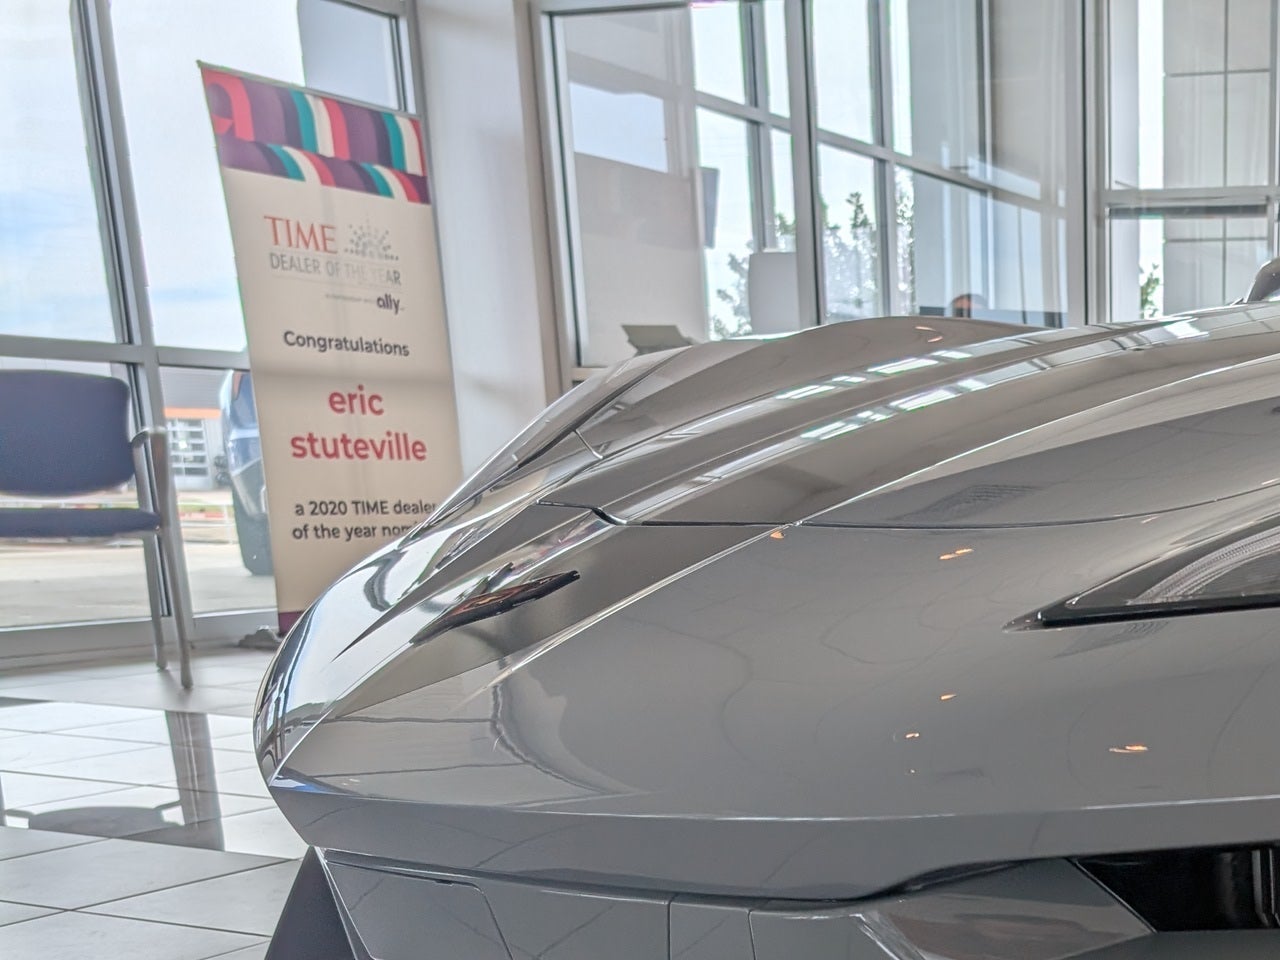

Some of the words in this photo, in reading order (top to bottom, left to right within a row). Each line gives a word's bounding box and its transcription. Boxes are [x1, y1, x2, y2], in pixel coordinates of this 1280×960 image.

[263, 215, 338, 254] TIME
[269, 252, 321, 275] DEALER
[326, 260, 341, 277] OF
[376, 293, 400, 315] ally
[283, 330, 410, 357] Congratulations
[328, 384, 385, 416] eric
[290, 430, 428, 461] stuteville
[295, 503, 304, 516] a
[309, 500, 348, 516] 2020
[351, 500, 389, 514] TIME
[292, 523, 309, 539] of
[314, 523, 340, 538] the
[345, 525, 376, 541] year
